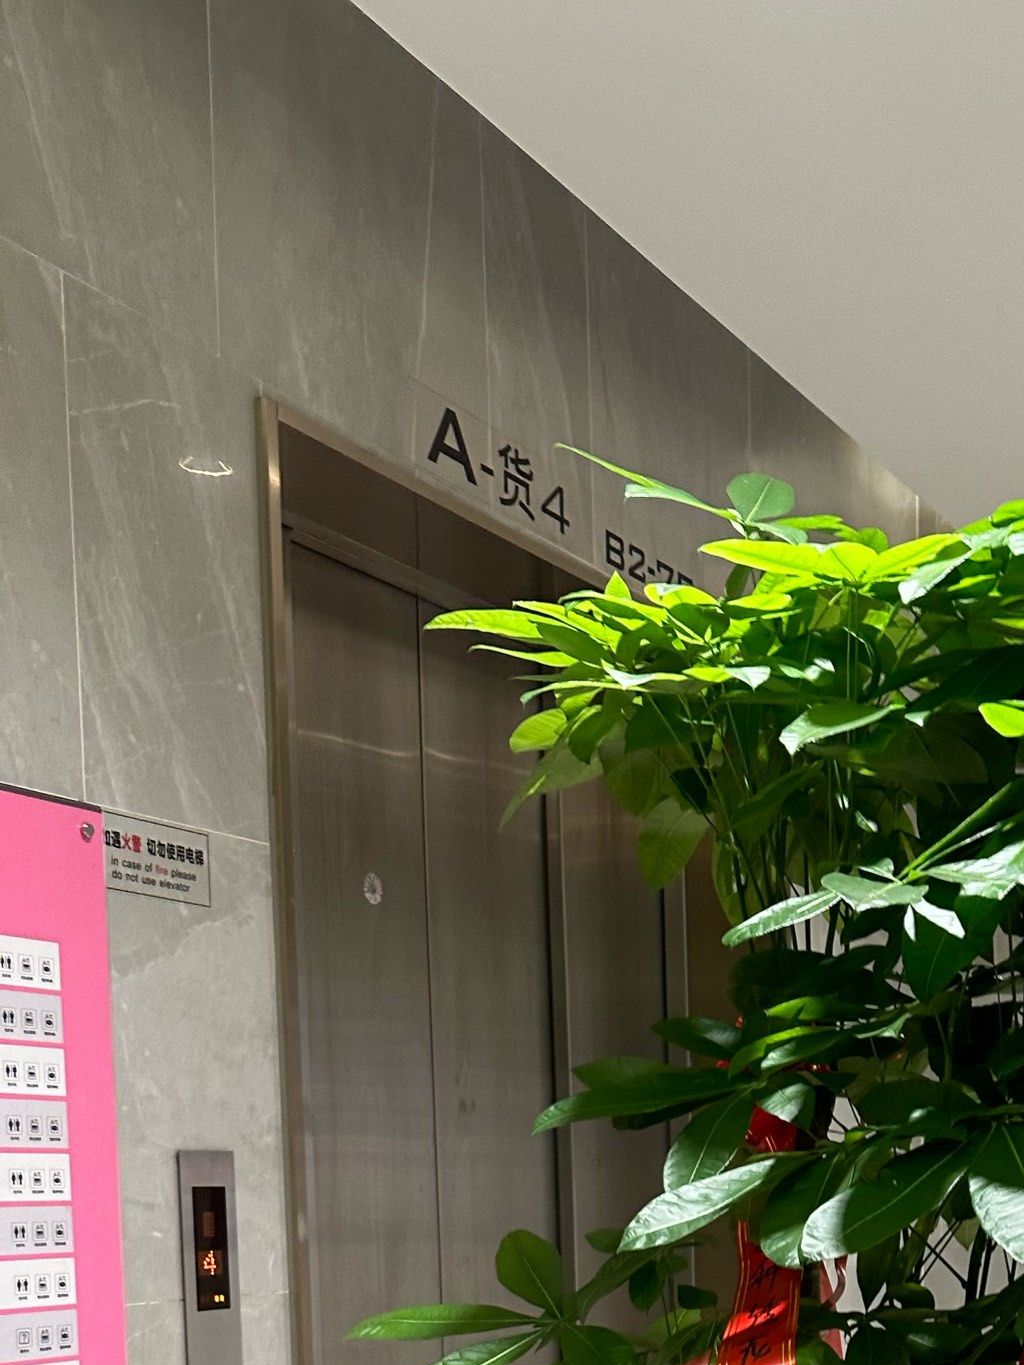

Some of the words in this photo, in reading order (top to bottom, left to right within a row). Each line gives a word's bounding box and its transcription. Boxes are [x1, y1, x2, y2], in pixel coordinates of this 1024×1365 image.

[605, 529, 694, 585] B2-7
[147, 838, 204, 866] 切勿使用电梯
[112, 870, 122, 880] do
[125, 873, 139, 883] not
[141, 876, 156, 886] use
[159, 880, 191, 892] elevator
[122, 860, 142, 871] case
[145, 863, 153, 872] of
[155, 864, 169, 876] fire
[171, 869, 197, 881] please
[203, 1250, 217, 1275] 4
